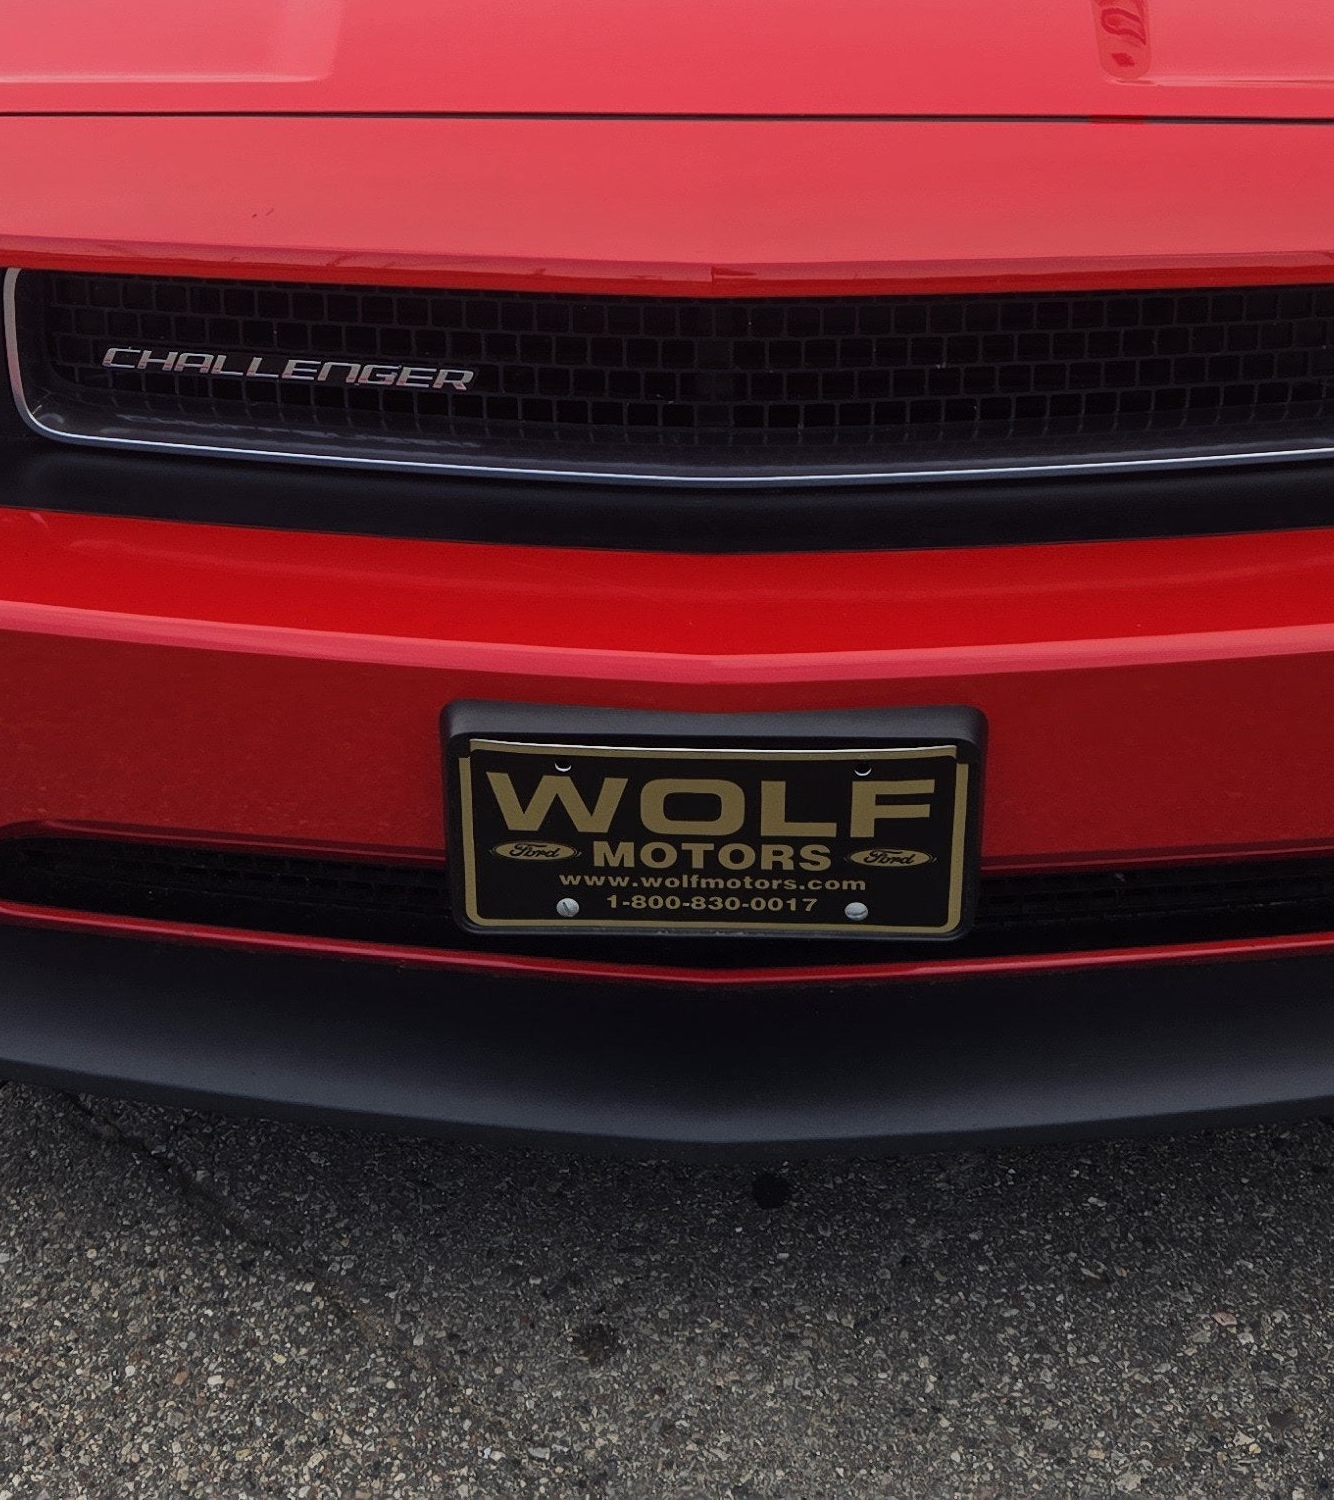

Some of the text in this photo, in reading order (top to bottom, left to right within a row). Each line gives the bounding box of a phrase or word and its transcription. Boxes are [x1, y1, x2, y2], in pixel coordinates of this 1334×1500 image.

[102, 346, 474, 391] CHALLENGER
[486, 771, 936, 839] WOLF
[509, 843, 562, 860] Ford
[593, 841, 832, 872] MOTORS
[864, 849, 916, 866] Ford
[559, 873, 867, 891] www.wolfmotors.com
[606, 894, 818, 913] 1-800-830-0017
